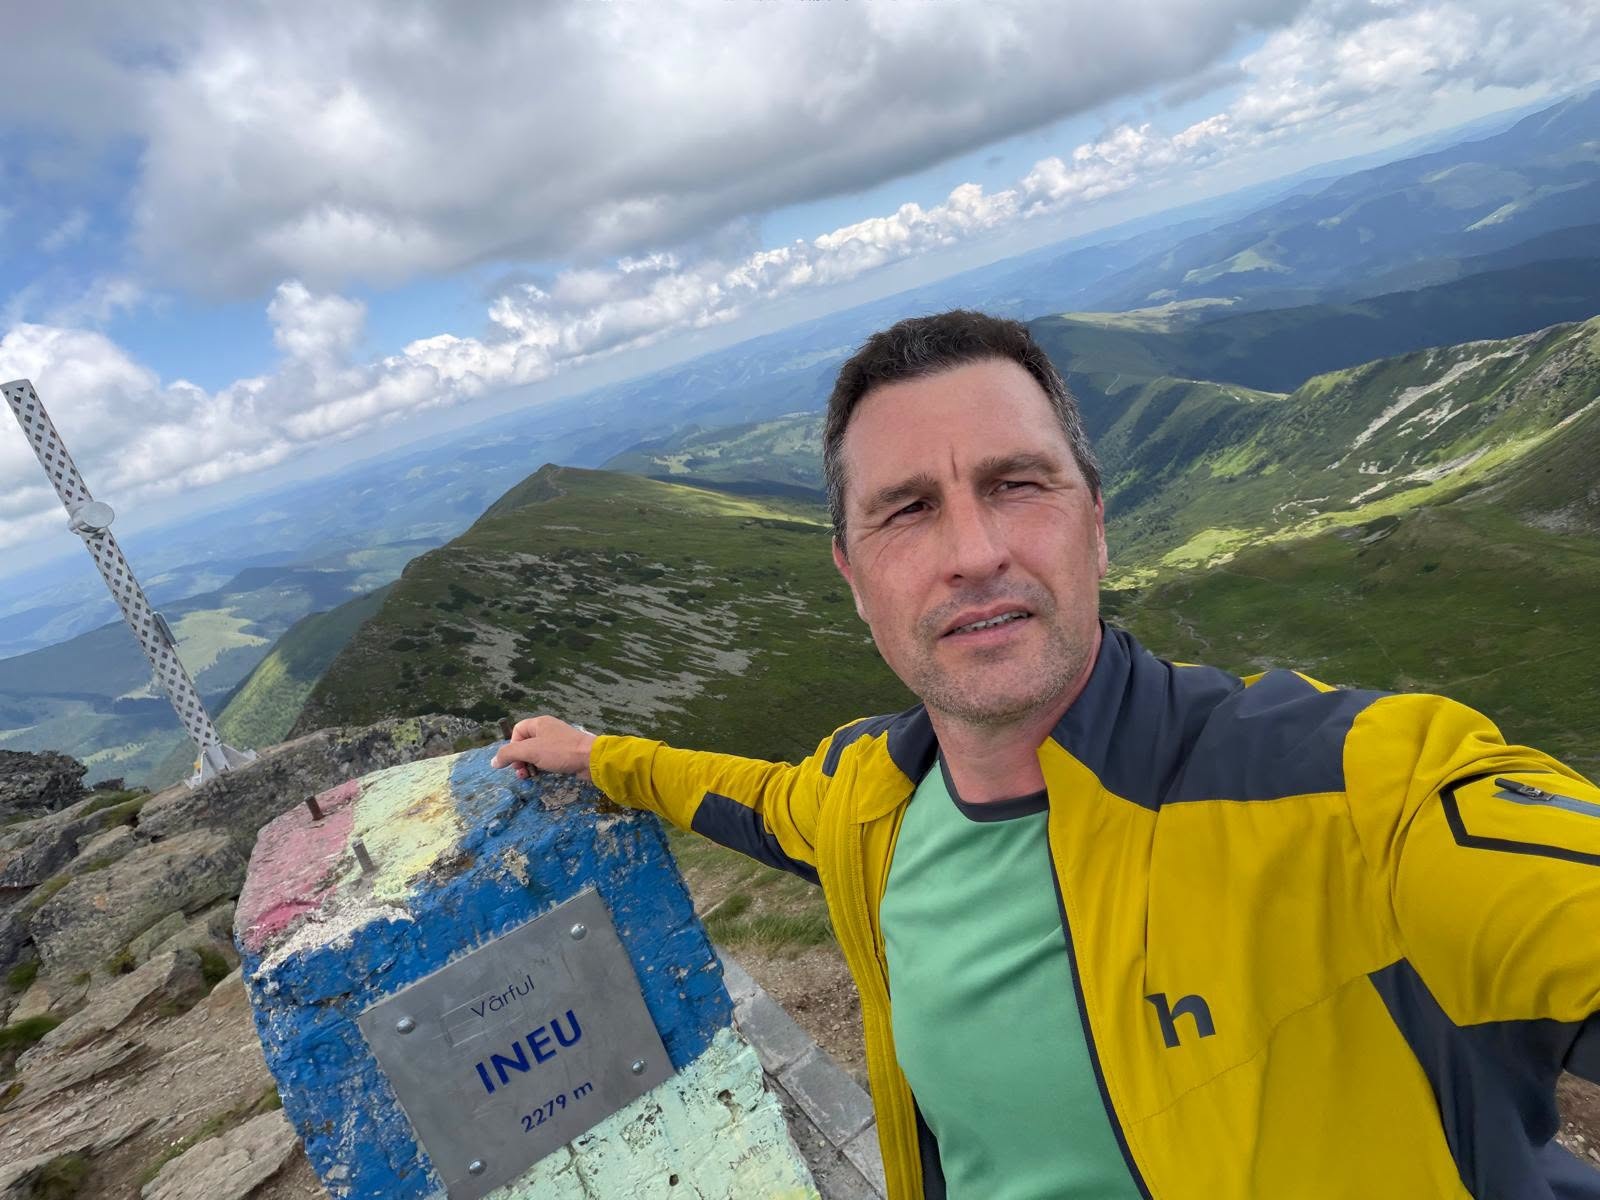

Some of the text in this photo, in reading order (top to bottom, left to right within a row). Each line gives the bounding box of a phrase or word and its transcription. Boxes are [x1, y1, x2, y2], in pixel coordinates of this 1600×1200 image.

[470, 974, 535, 1018] Vârful
[475, 1009, 582, 1095] INEU
[521, 1081, 593, 1133] 2279 m
